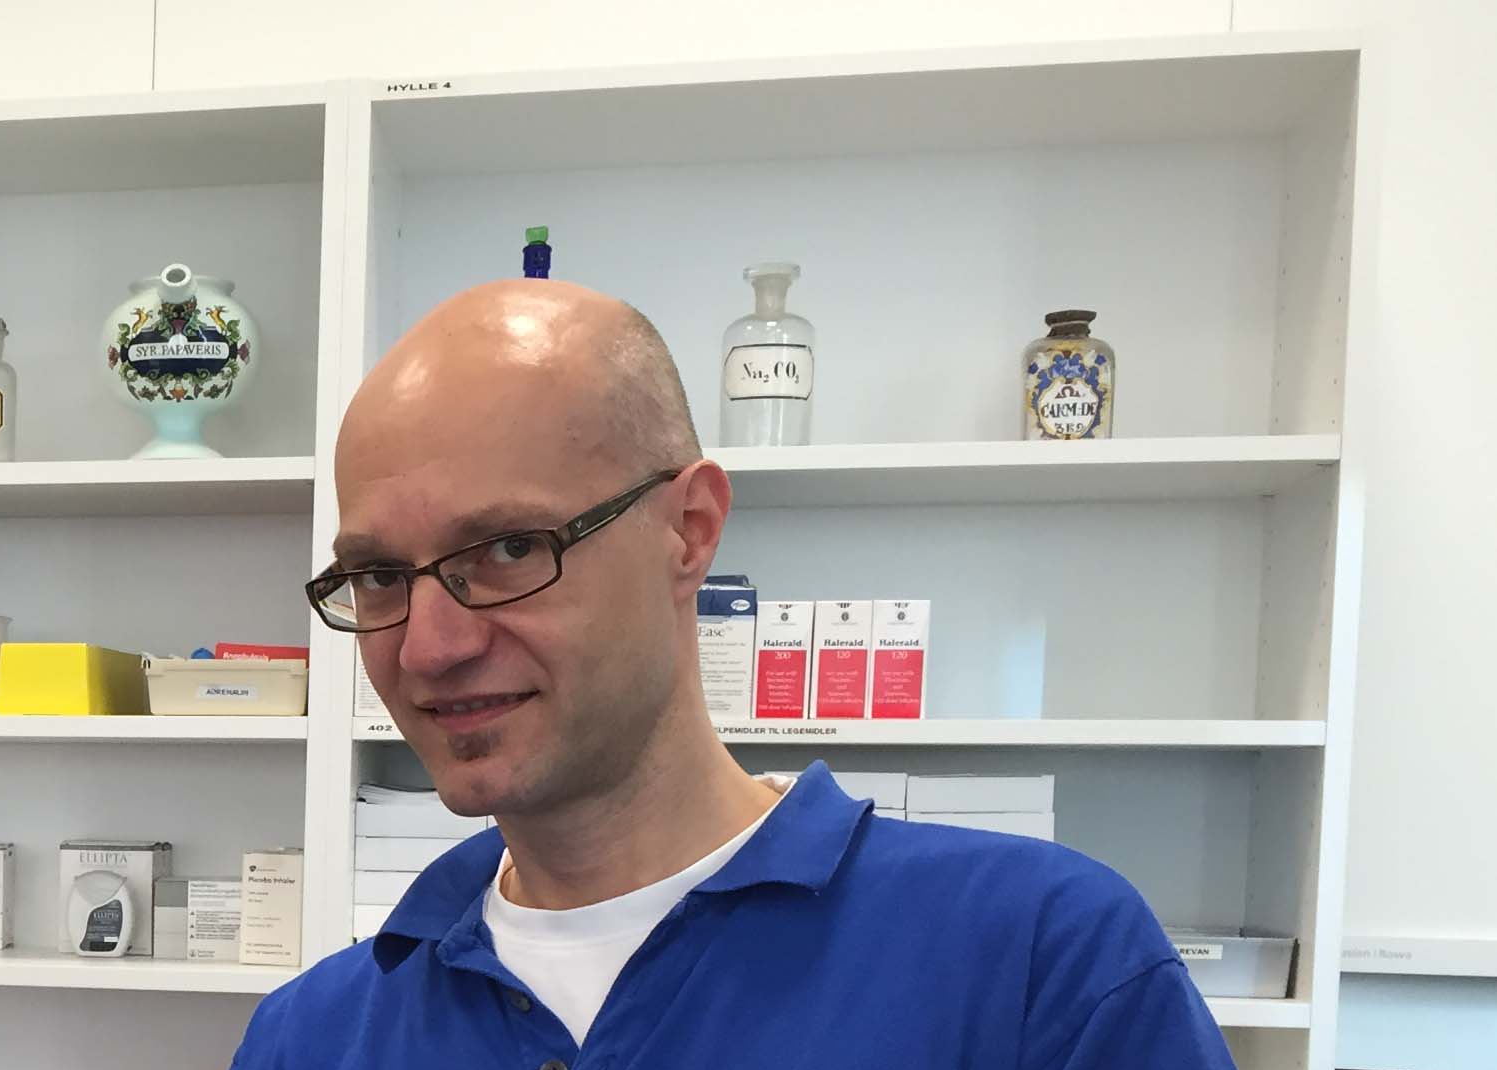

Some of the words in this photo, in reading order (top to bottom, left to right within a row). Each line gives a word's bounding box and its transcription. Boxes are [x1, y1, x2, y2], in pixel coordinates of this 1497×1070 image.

[387, 82, 438, 92] HYLLE
[443, 81, 452, 89] 4
[161, 344, 222, 357] PAPAVERIS
[367, 724, 393, 732] 402
[782, 727, 837, 735] LEGEMIDLER
